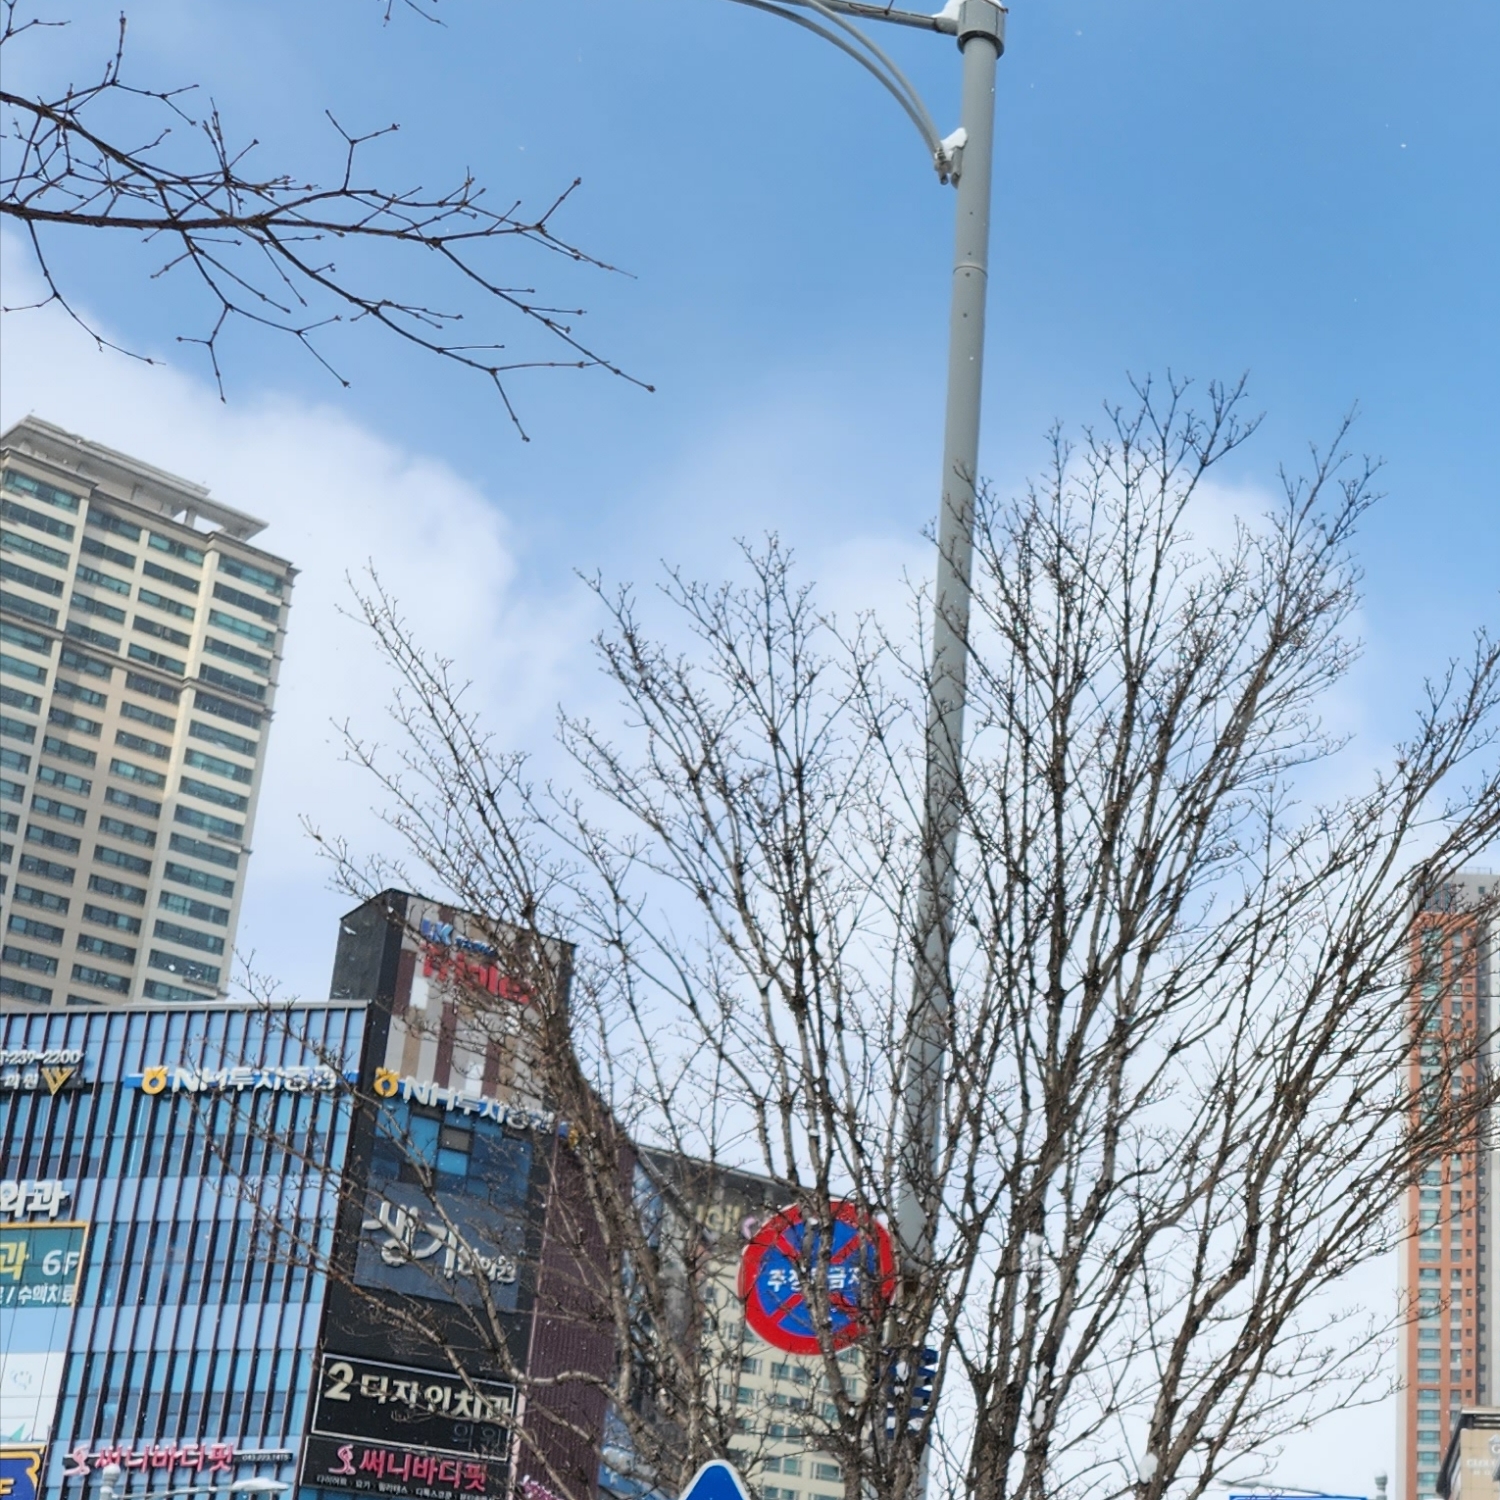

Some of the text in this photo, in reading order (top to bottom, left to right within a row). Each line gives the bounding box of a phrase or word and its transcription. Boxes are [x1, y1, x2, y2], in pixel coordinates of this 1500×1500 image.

[172, 1065, 337, 1093] NH투자증권
[42, 1249, 80, 1277] 6F
[359, 1448, 489, 1493] 써니바디핏
